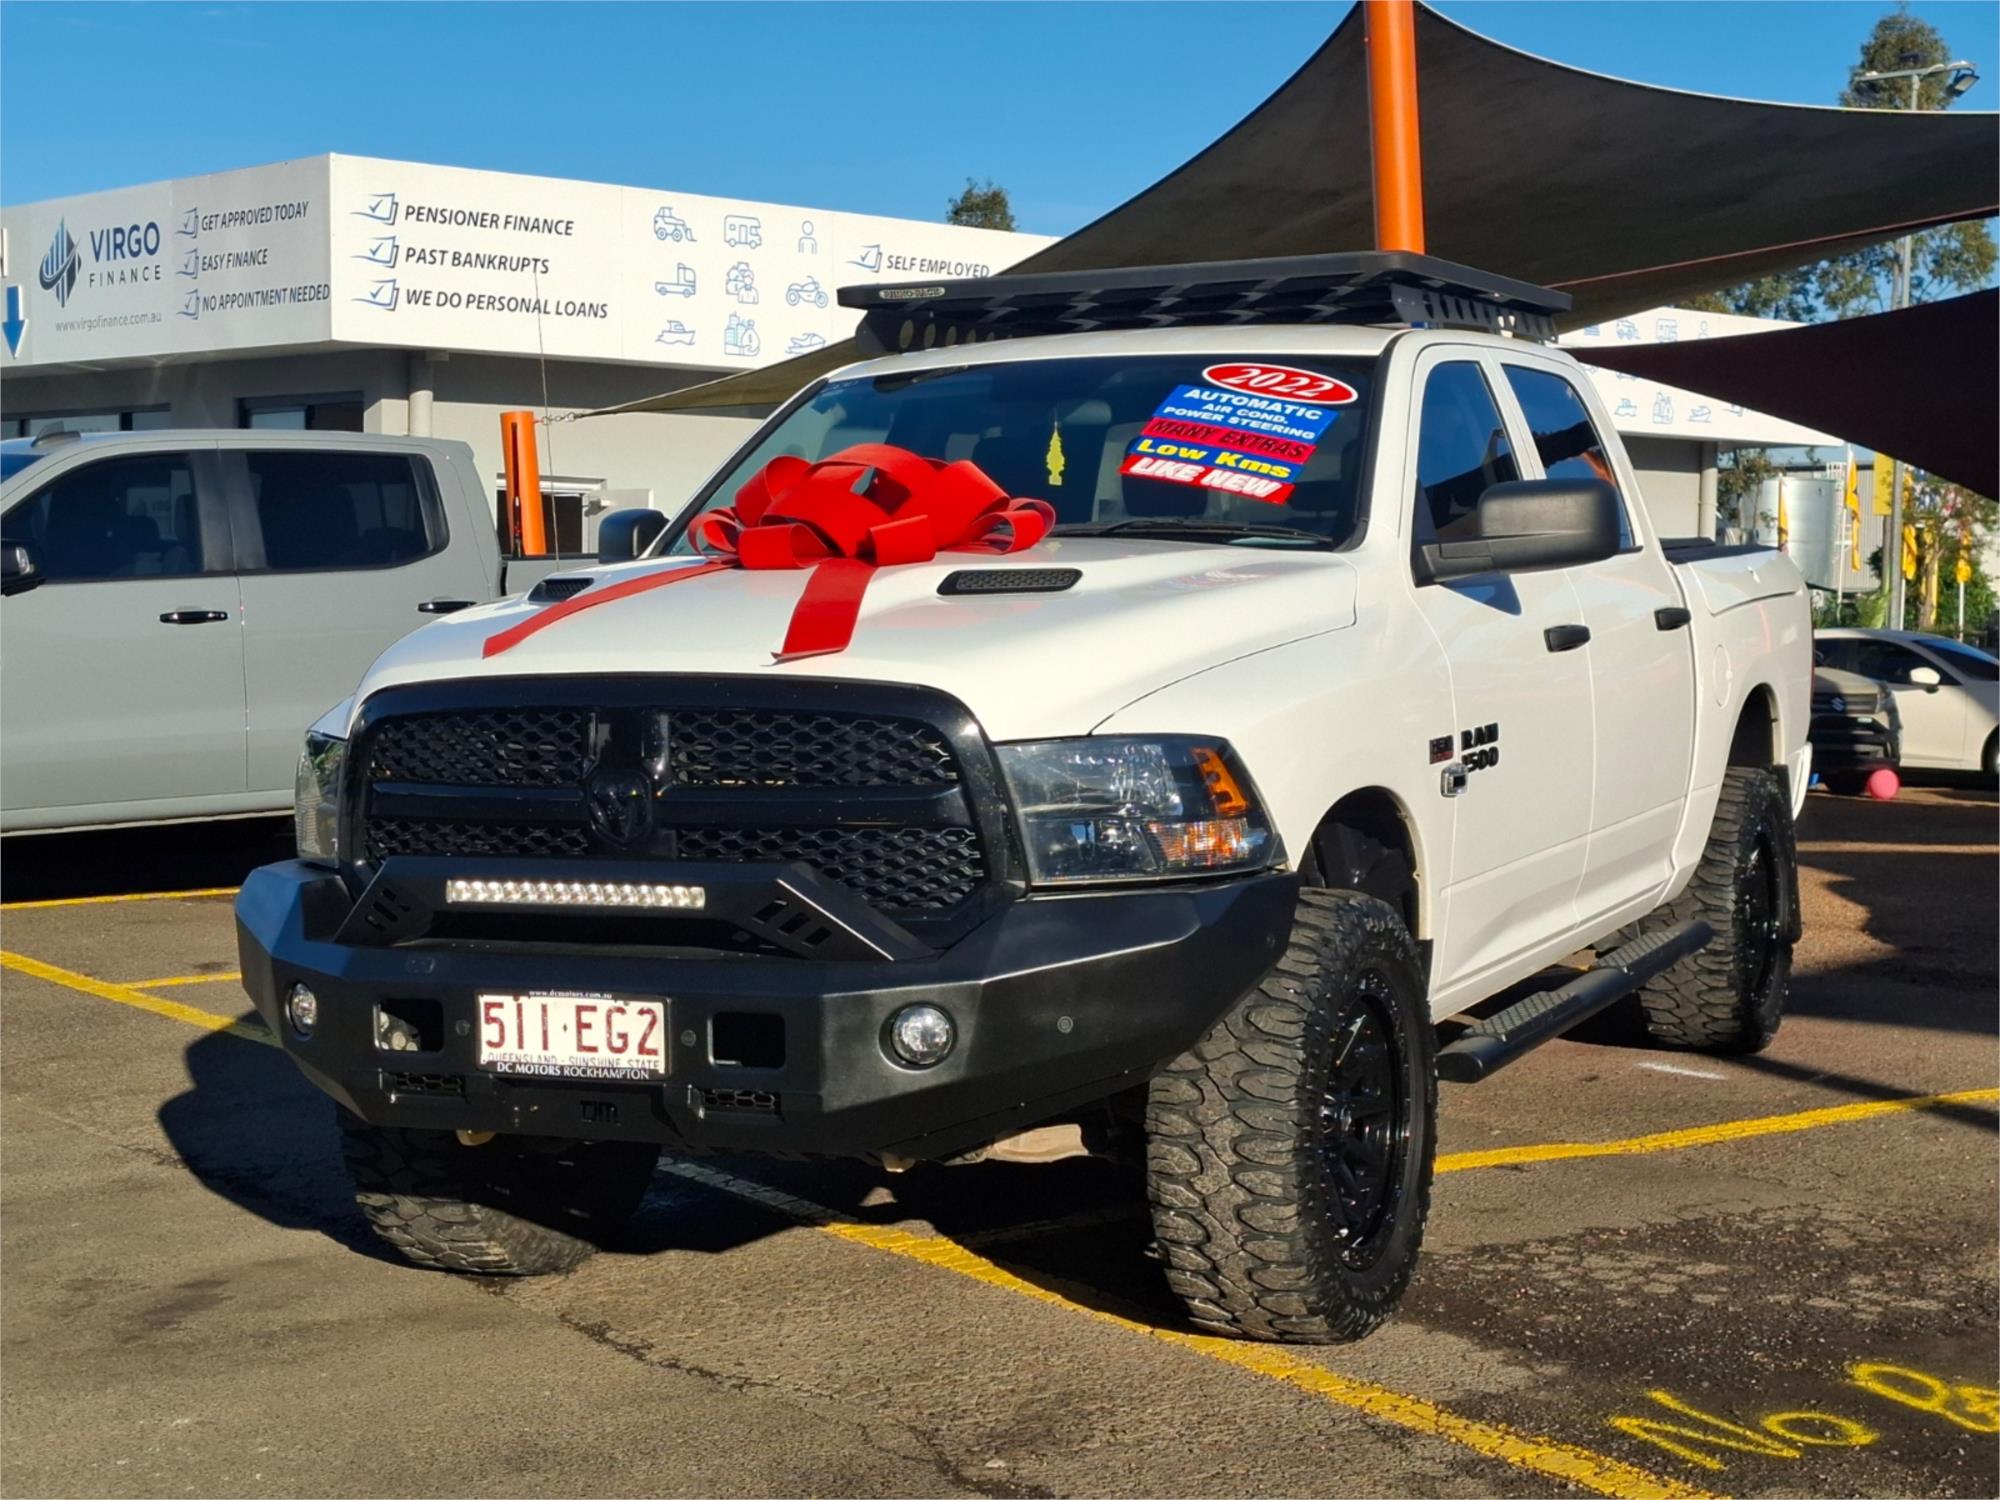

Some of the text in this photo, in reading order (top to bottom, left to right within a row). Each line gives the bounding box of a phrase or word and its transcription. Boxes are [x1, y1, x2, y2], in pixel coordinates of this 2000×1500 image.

[200, 201, 309, 232] GET APPROVED TODAY
[404, 205, 575, 236] PENSIONER FINANCE
[89, 221, 161, 263] VIRGO
[201, 248, 268, 272] EASY FINANCE
[405, 247, 550, 274] PAST BANKRUPTS
[886, 254, 990, 279] SELF EMPLOYED
[89, 264, 162, 288] FINANCE
[202, 283, 330, 312] NO APPOINTMENT NEEDED
[406, 288, 608, 319] WE DO PERSONAL LOANS
[55, 310, 162, 332] www.virgofinance.com.au
[1220, 368, 1334, 397] 2022
[1183, 389, 1323, 420] AUTOMATIC
[1202, 403, 1289, 424] AIR COND.
[1163, 406, 1316, 440] POWER STEERING
[1151, 420, 1306, 459] MANY EXTRAS
[1137, 439, 1292, 478] Low Kms
[1129, 457, 1283, 498] LIKE NEW
[1460, 722, 1499, 751] RAM
[496, 1062, 650, 1080] DC MOTORS ROCKHAMPTON
